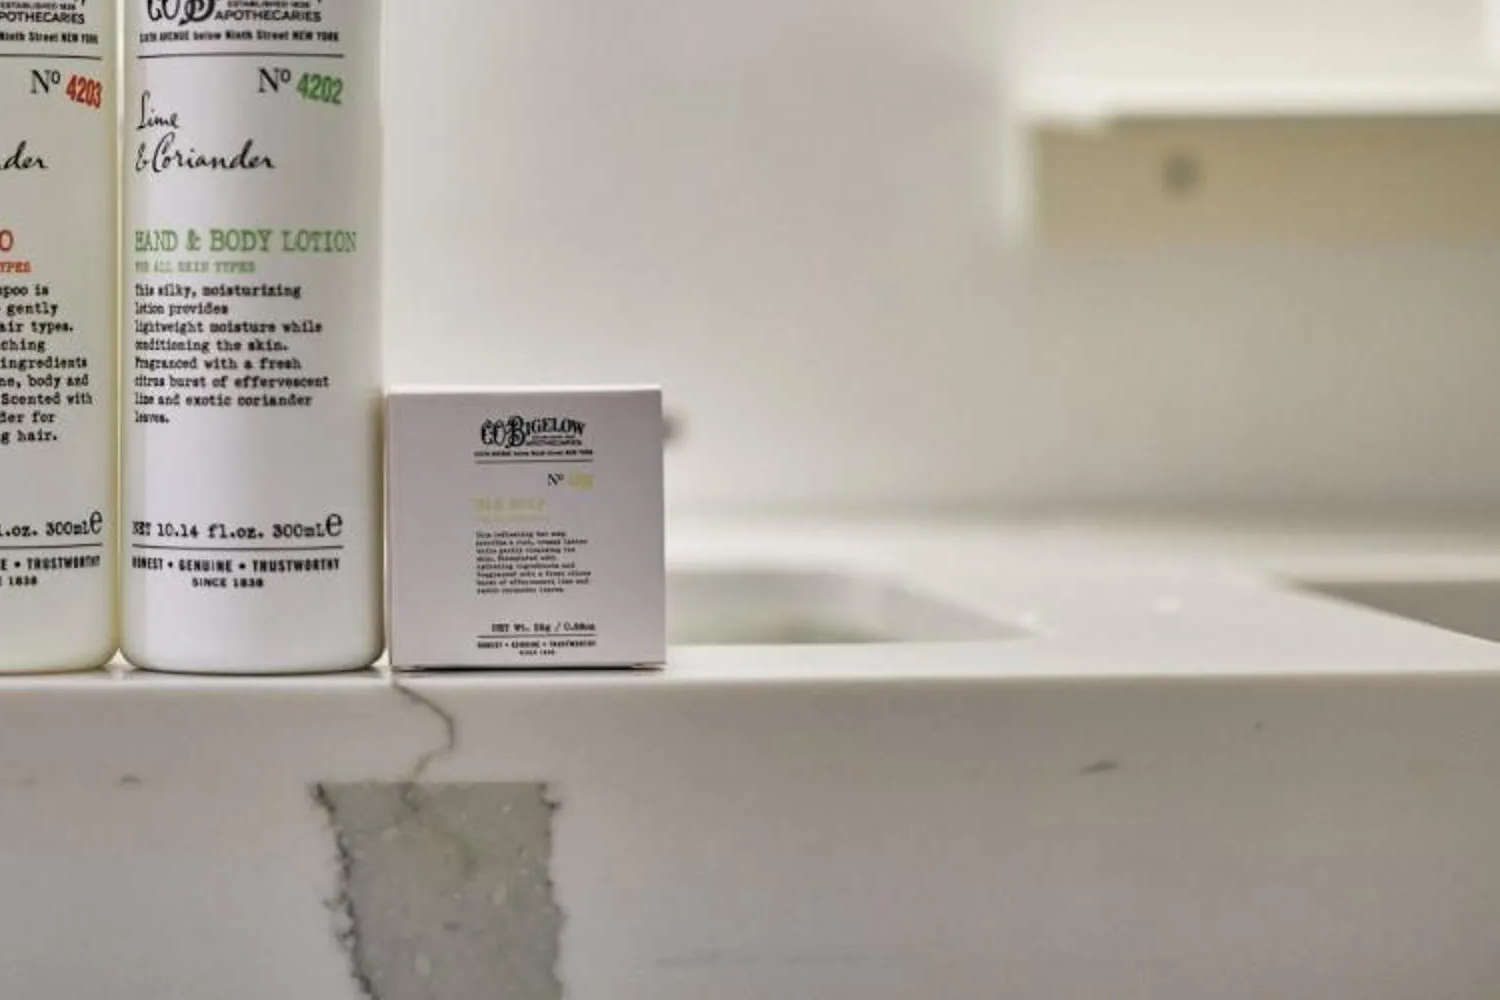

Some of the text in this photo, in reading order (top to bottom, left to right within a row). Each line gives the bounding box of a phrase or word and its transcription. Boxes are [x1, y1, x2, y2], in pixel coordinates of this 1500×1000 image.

[215, 10, 321, 22] APOTHECARIES
[28, 32, 59, 42] Street
[66, 74, 102, 109] 4203
[297, 72, 343, 105] 4202
[136, 90, 180, 130] Lime
[152, 132, 275, 172] Coriander
[136, 230, 177, 252] HAND
[210, 230, 272, 252] BODY
[283, 230, 356, 252] LOTION
[35, 285, 48, 296] is
[158, 285, 196, 298] silky,
[7, 303, 58, 316] gently
[169, 303, 228, 316] provides
[210, 321, 275, 333] moisture
[282, 321, 322, 333] while
[217, 340, 287, 351] the skin.
[1, 358, 87, 370] ingredients
[204, 358, 237, 369] with
[244, 360, 252, 369] a
[260, 358, 301, 369] fresh
[28, 376, 60, 389] body
[67, 376, 88, 387] and
[170, 376, 329, 387] burst of effervescent
[1, 394, 60, 405] Scented
[67, 394, 92, 405] with
[158, 394, 312, 406] and exotic coriander
[32, 412, 55, 424] for
[17, 431, 57, 442] hair.
[157, 523, 198, 537] 10.14
[27, 556, 100, 570] TRUSTWORTHY
[179, 558, 339, 571] GENUINE TRUSTWORTHY
